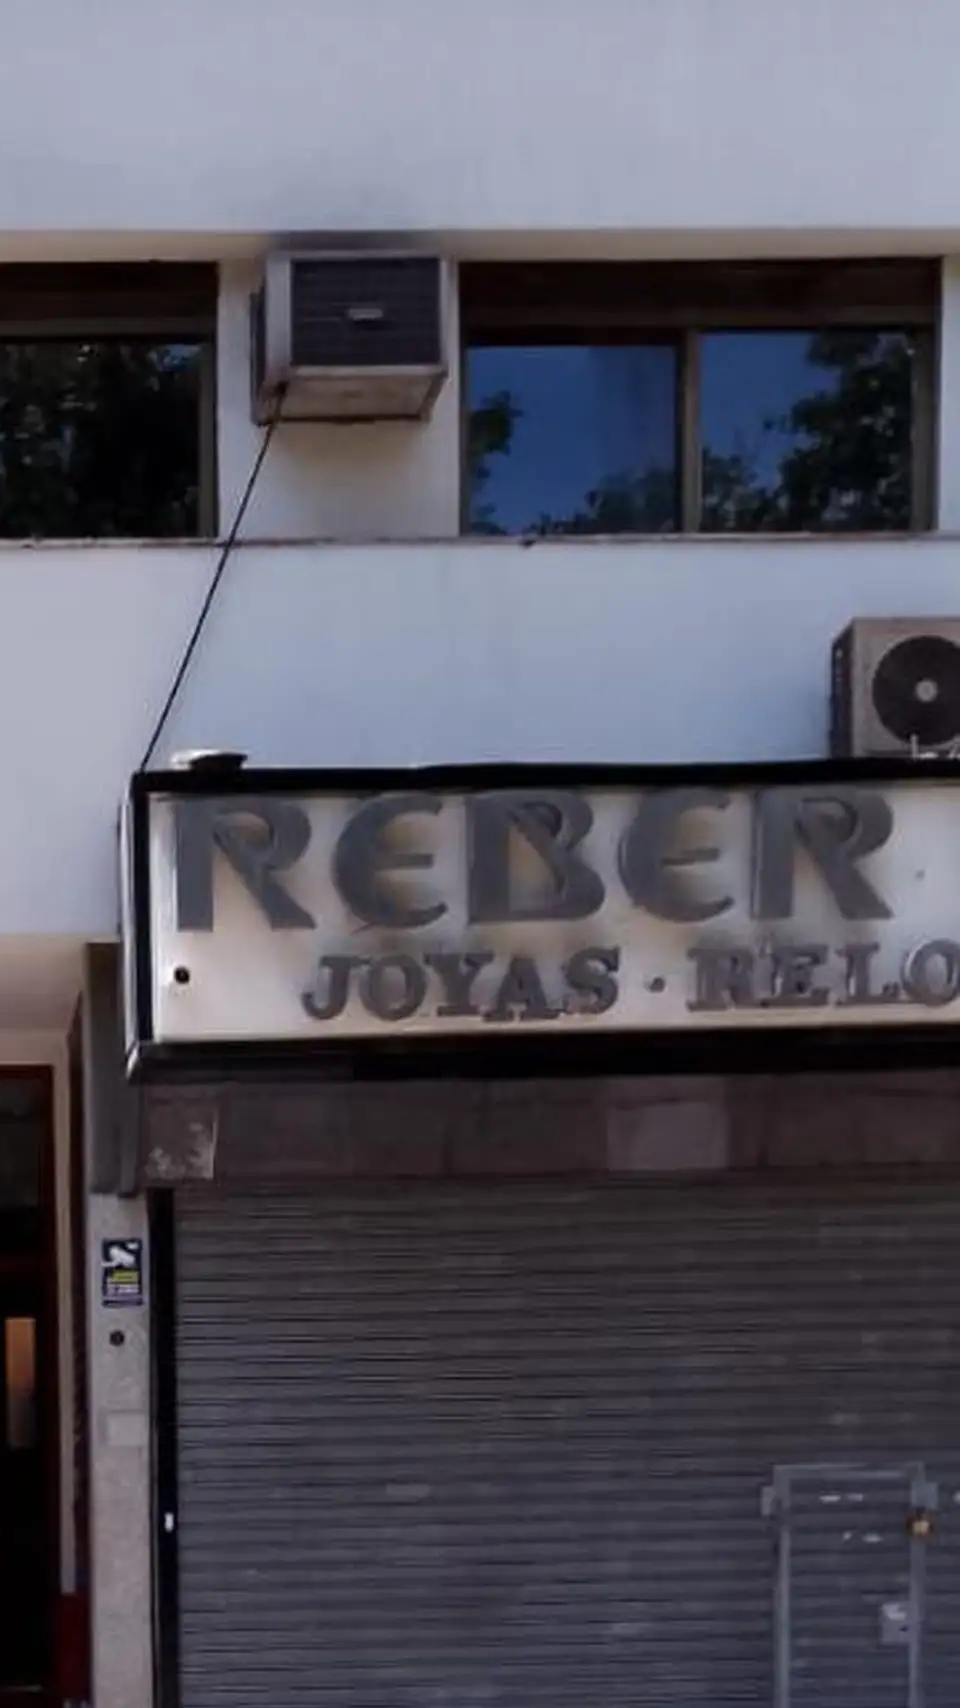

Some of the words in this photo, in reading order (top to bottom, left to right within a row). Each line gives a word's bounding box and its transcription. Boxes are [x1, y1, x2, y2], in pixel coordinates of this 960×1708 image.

[175, 789, 895, 932] REBER
[301, 946, 621, 1022] JOYAS
[686, 938, 960, 1011] RELO
